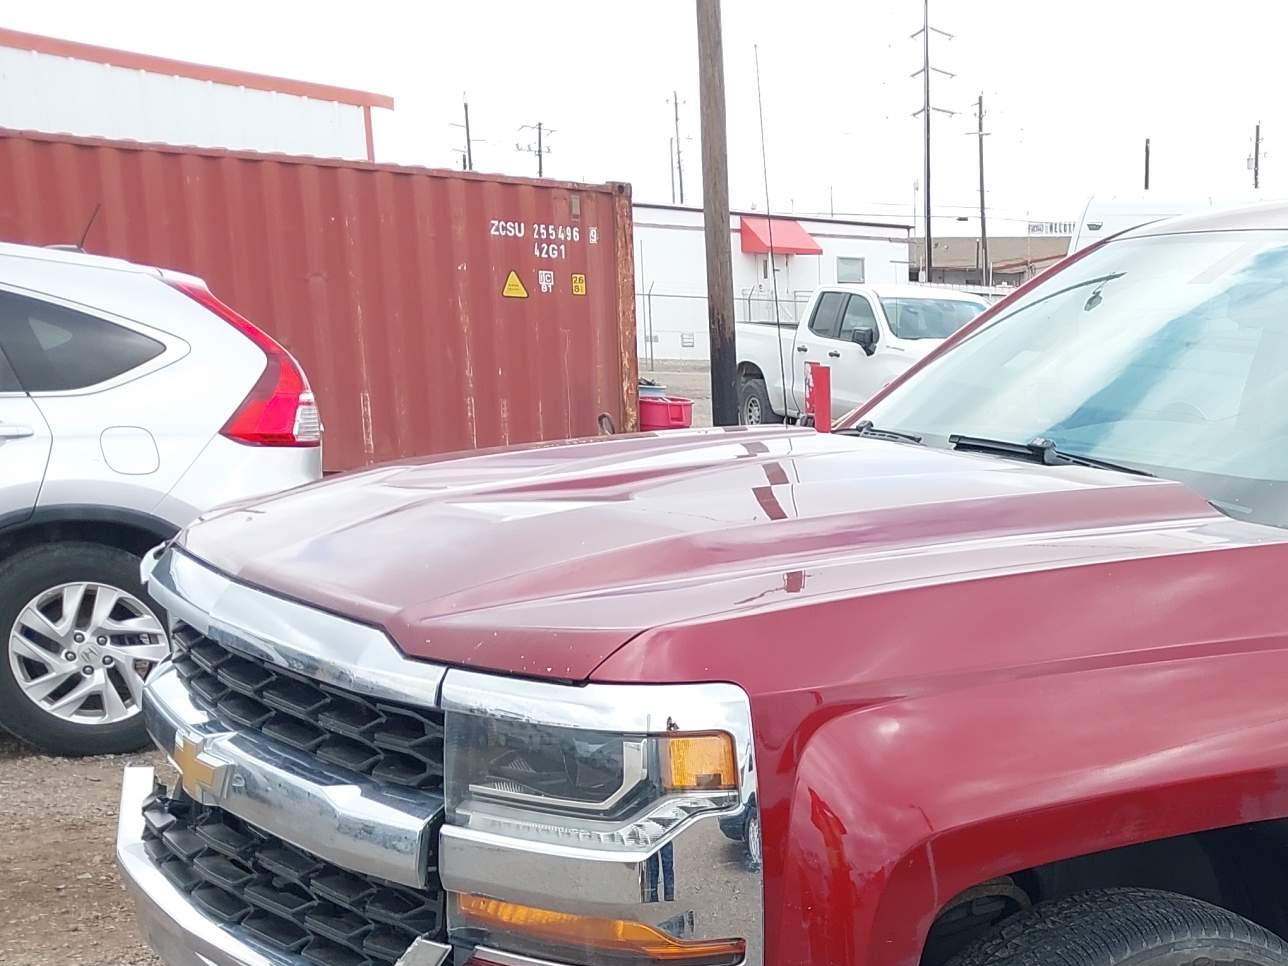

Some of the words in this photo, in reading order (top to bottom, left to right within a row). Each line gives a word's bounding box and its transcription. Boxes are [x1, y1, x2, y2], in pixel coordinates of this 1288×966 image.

[490, 220, 525, 237] ZCSU
[533, 224, 580, 241] 255496
[534, 243, 566, 259] 42G1
